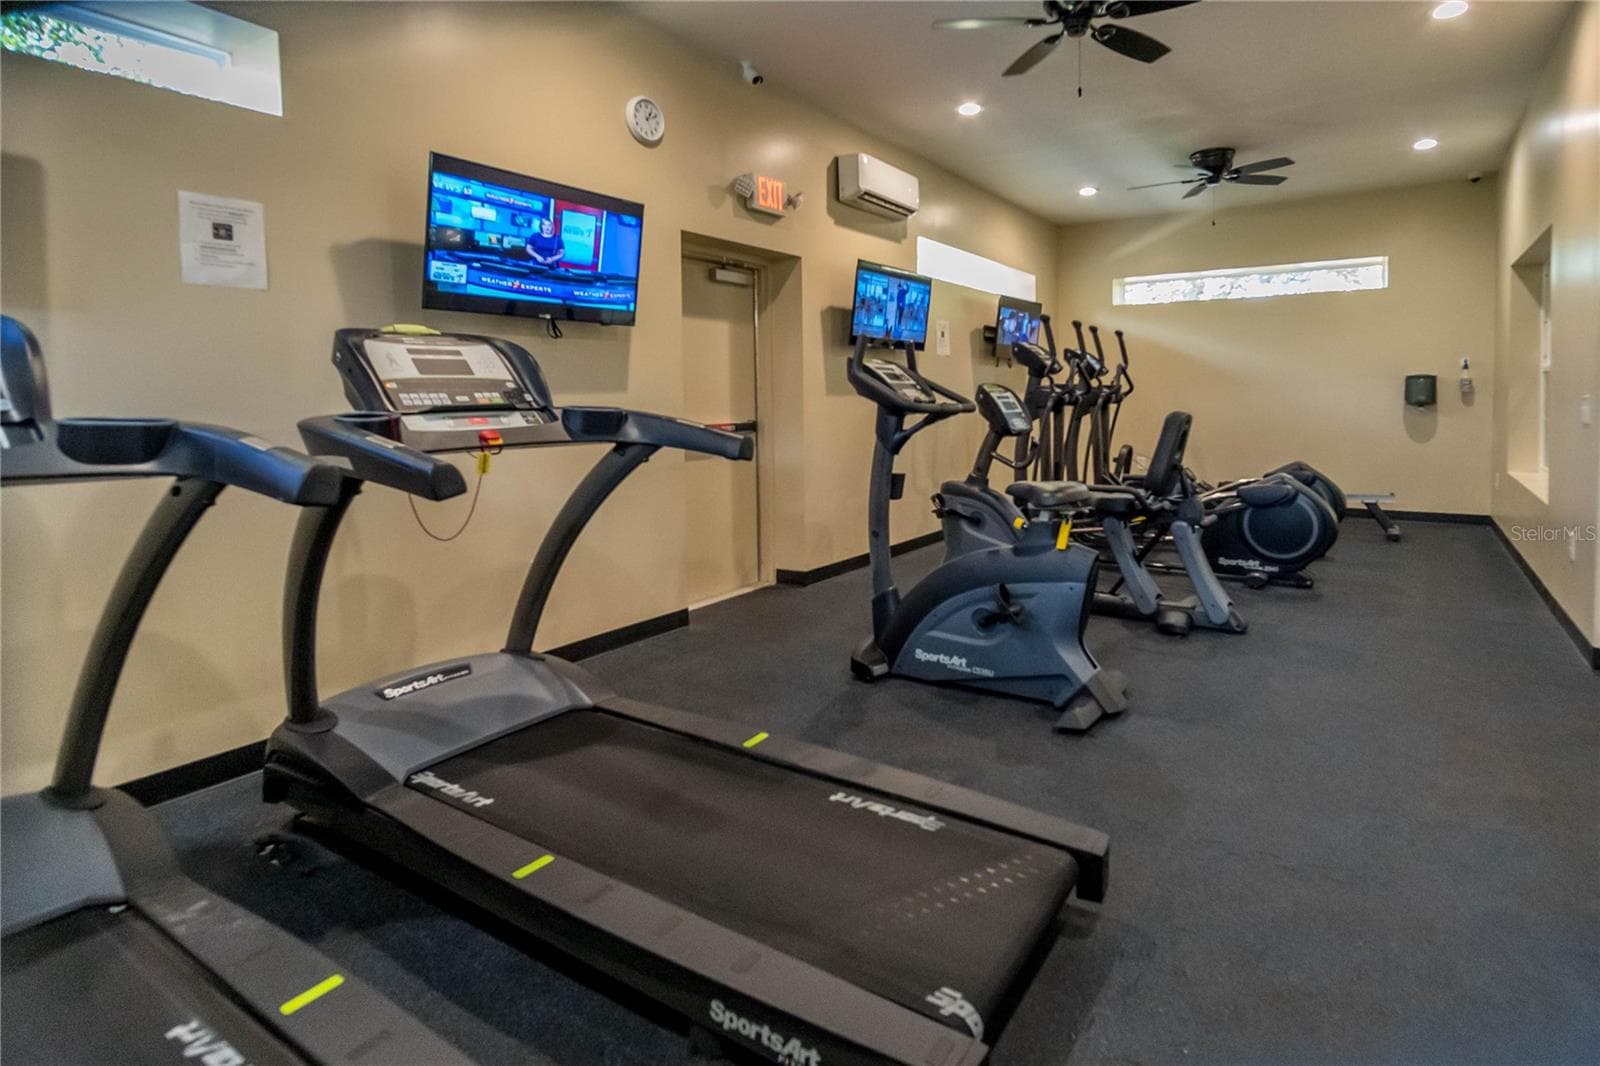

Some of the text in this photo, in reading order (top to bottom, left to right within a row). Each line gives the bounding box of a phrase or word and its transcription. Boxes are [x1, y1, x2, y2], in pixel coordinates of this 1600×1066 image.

[758, 175, 783, 210] EXIT
[914, 648, 967, 668] SportsArt
[383, 673, 445, 698] SportsArt
[709, 999, 822, 1066] SportsArt
